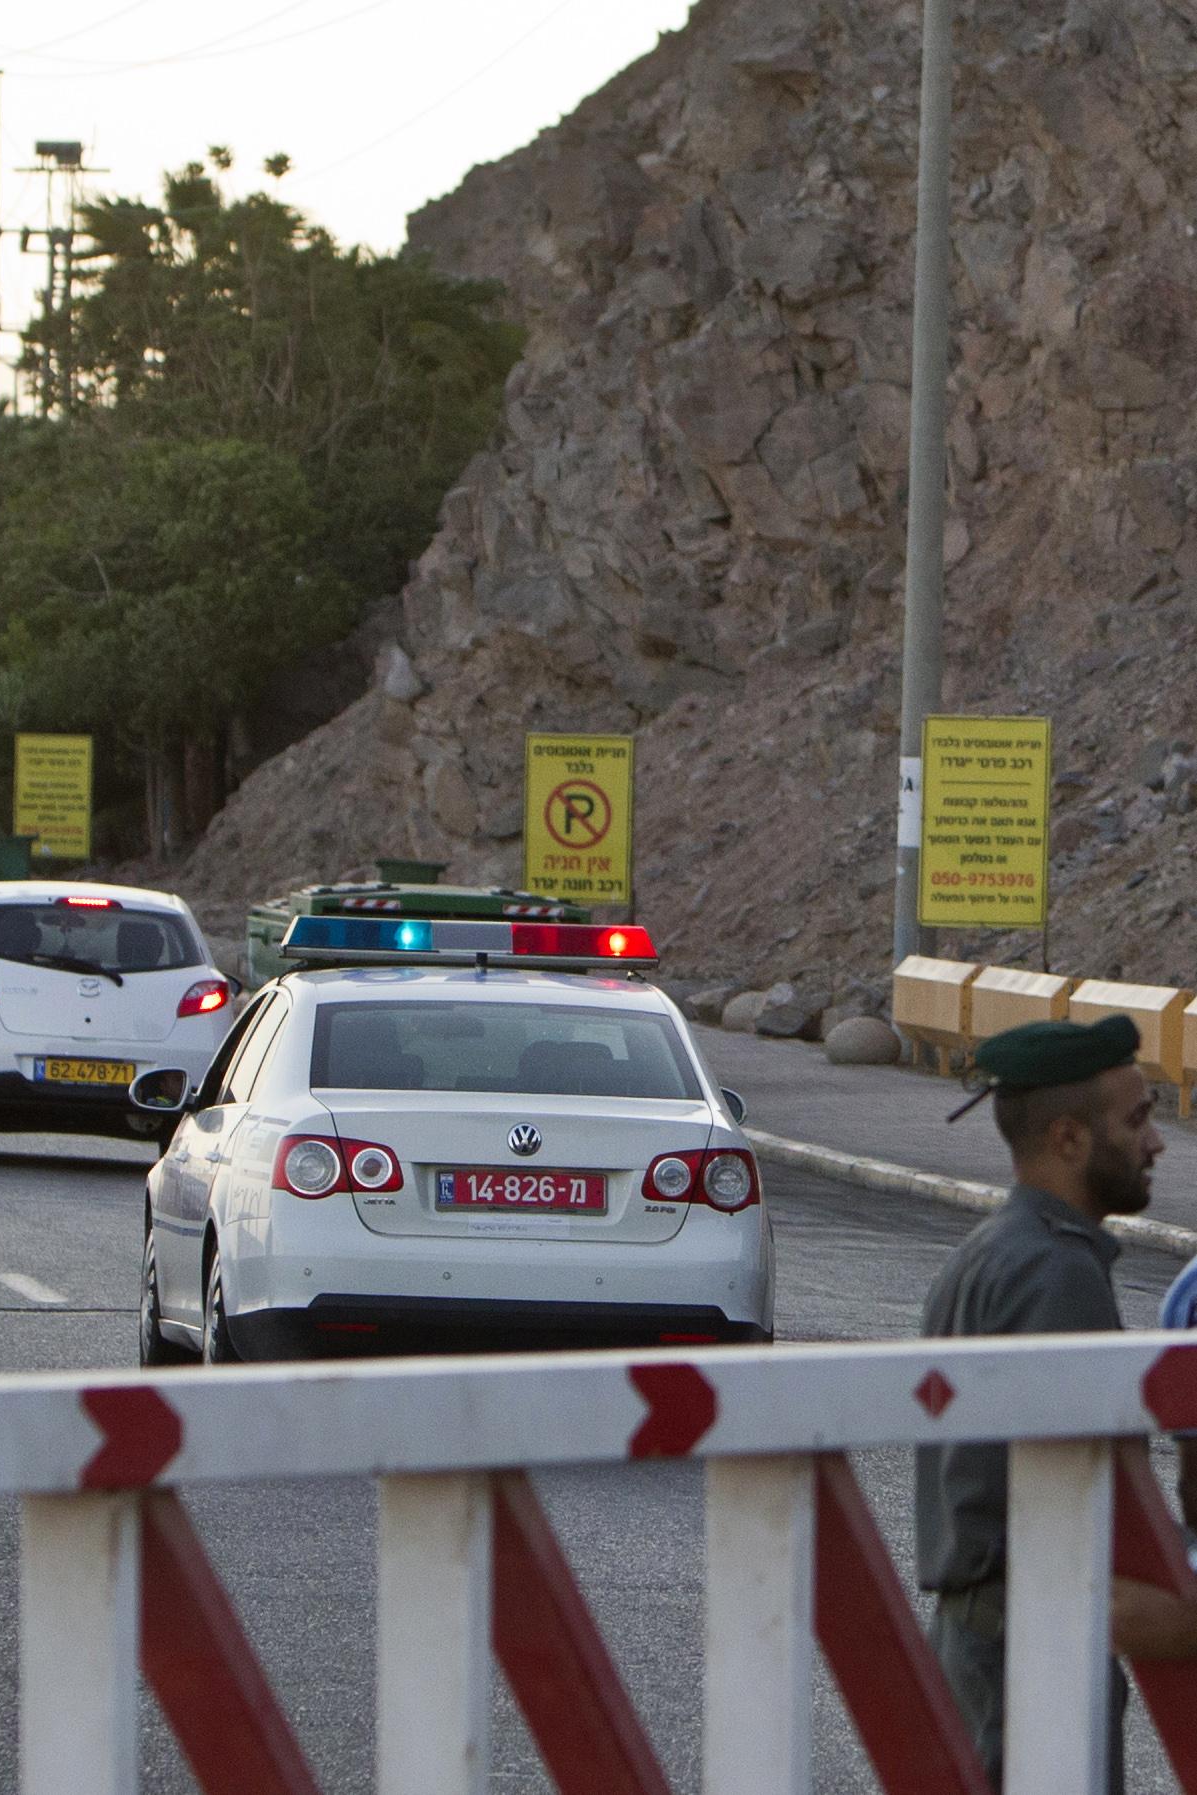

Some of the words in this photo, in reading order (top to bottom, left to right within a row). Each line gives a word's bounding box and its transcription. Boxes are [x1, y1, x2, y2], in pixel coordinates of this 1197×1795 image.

[533, 745, 591, 757] אוטובוסים
[565, 760, 594, 774] בלבד
[978, 757, 1006, 769] פרטי
[1010, 758, 1033, 769] רכב
[543, 855, 581, 870] חניה
[587, 856, 612, 874] אין
[562, 878, 592, 891] חונה
[597, 879, 622, 892] רכב
